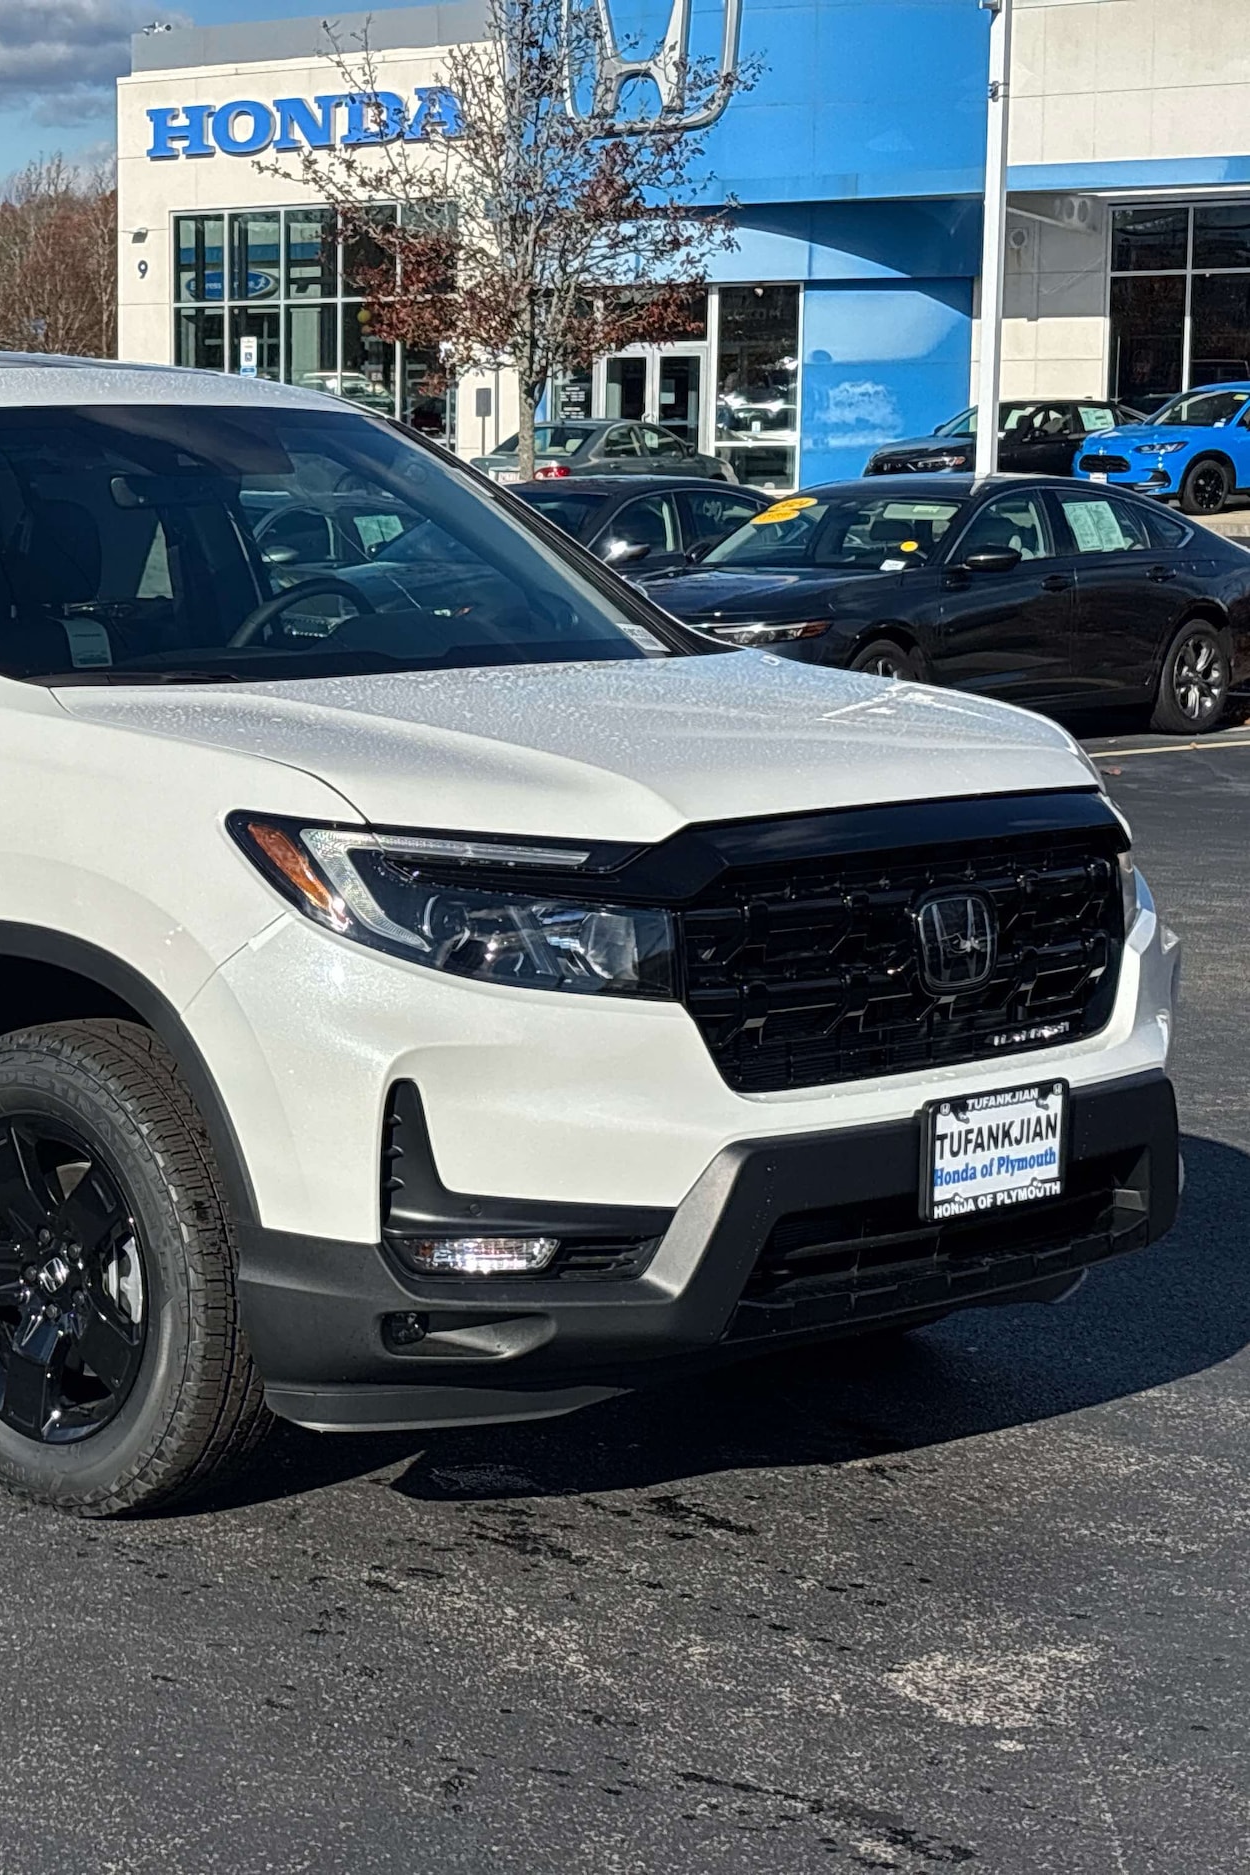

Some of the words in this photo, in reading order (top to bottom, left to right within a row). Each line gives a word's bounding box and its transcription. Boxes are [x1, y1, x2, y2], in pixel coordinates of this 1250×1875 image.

[146, 86, 468, 160] HONDA
[137, 260, 149, 279] 9
[966, 1088, 1039, 1111] TUFANKJIAN
[936, 1112, 1058, 1160] TUFANKJIAN
[934, 1162, 976, 1187] Honda
[980, 1158, 995, 1178] of
[996, 1147, 1056, 1177] Plymouth
[934, 1198, 976, 1219] HONDA
[977, 1193, 993, 1210] OF
[996, 1181, 1061, 1206] PLYMOUTH
